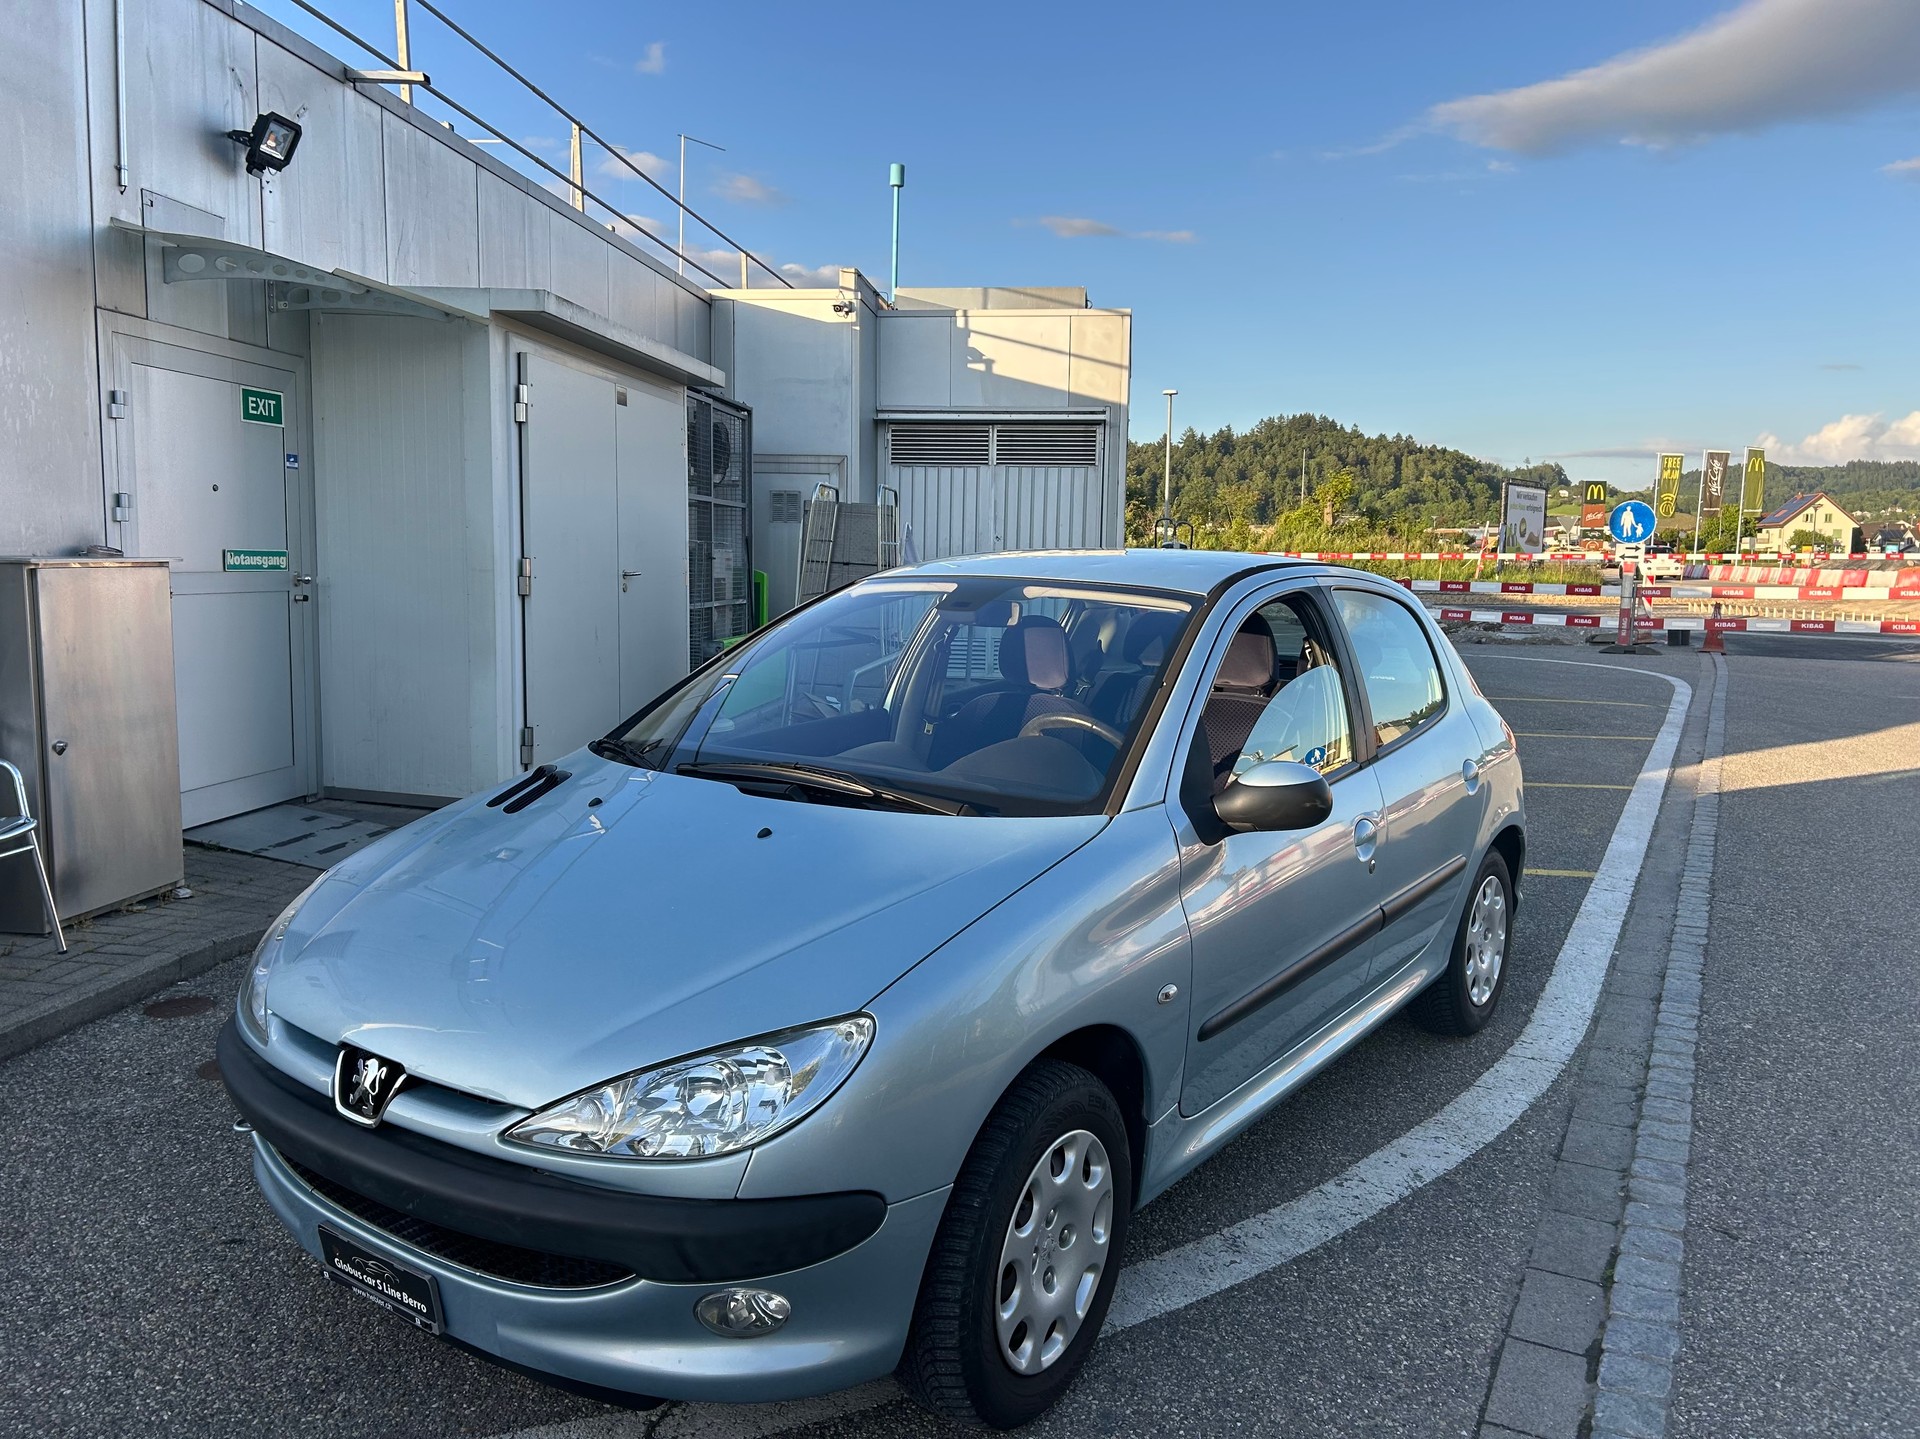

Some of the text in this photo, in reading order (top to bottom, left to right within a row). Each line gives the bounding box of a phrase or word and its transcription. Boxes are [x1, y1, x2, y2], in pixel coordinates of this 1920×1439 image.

[248, 396, 276, 417] EXIT
[1663, 457, 1681, 468] FREE
[1662, 469, 1680, 480] WLAN
[227, 552, 287, 568] Notausgang
[334, 1258, 362, 1280] Globus
[363, 1274, 376, 1287] car
[383, 1282, 402, 1301] Line
[402, 1291, 427, 1313] Berro
